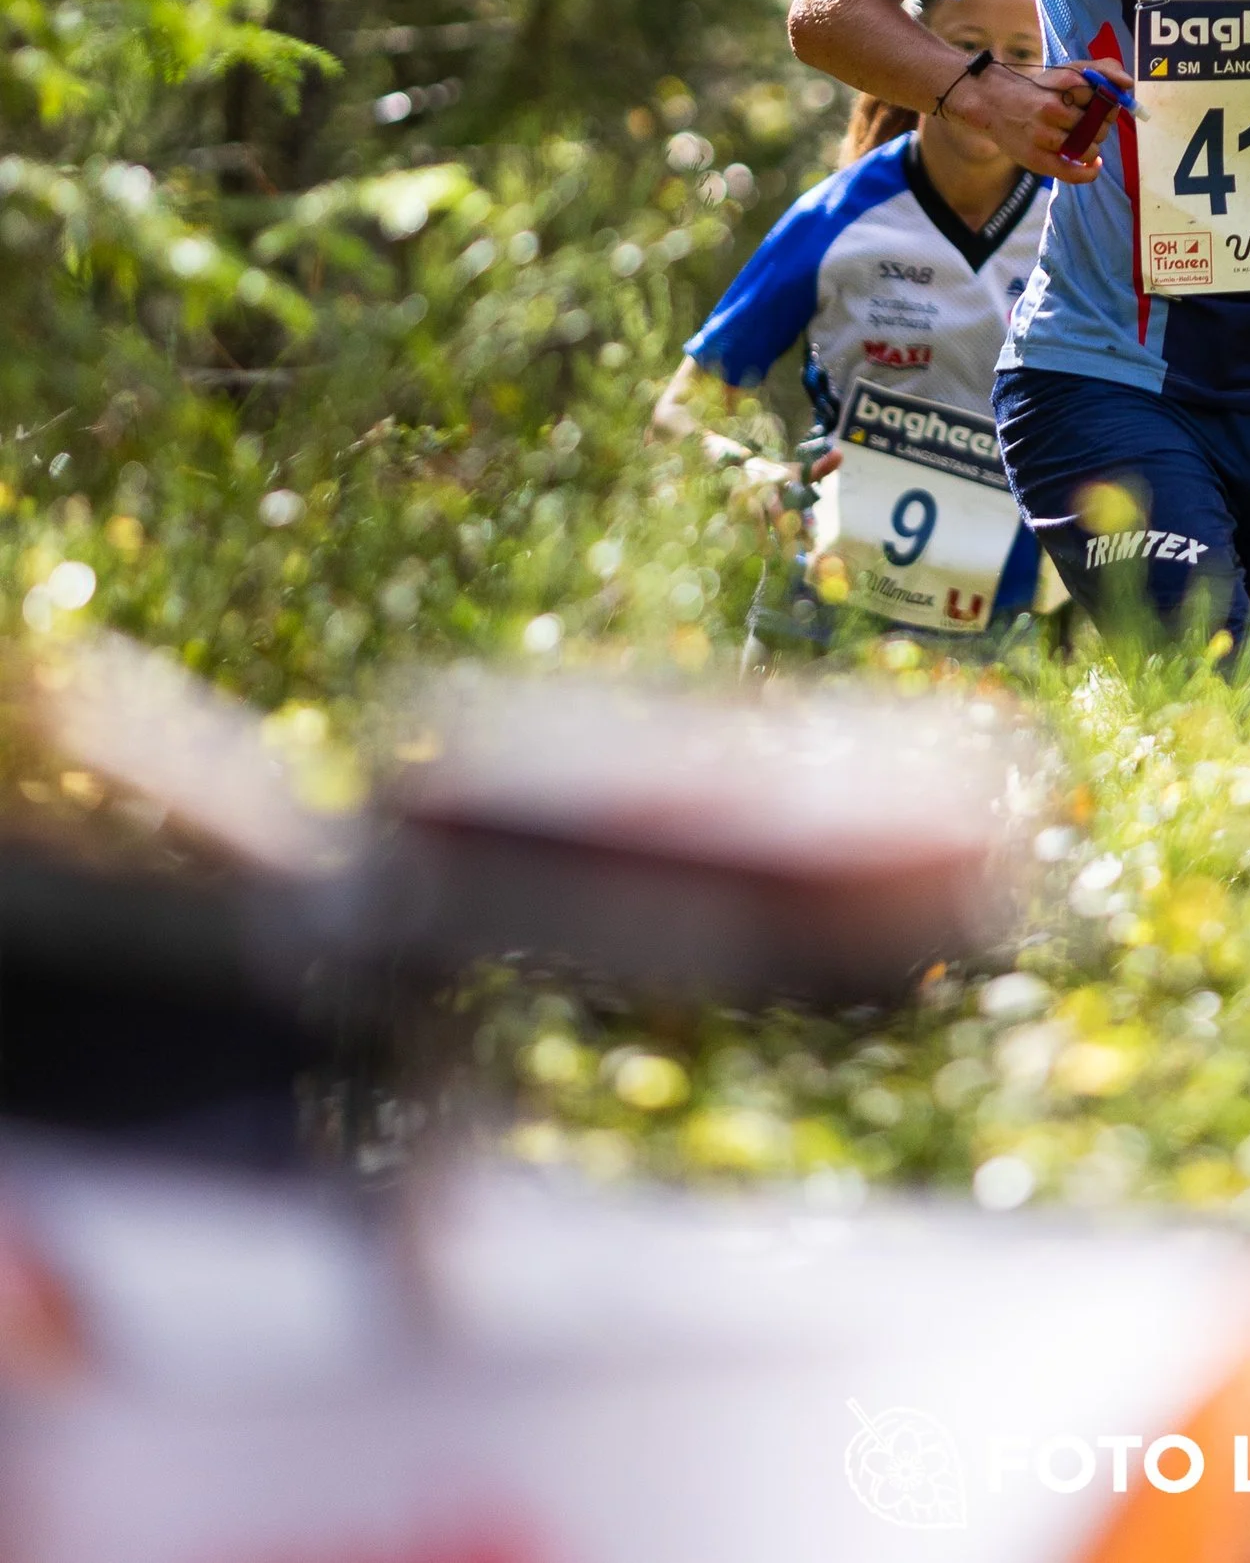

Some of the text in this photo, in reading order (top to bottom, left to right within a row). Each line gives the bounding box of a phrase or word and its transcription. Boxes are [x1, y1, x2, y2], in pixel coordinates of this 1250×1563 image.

[1177, 61, 1201, 75] SM
[878, 260, 935, 285] SSAB
[1154, 257, 1209, 270] Tisaren
[882, 487, 938, 568] 9
[1086, 530, 1209, 570] TRIMTEX
